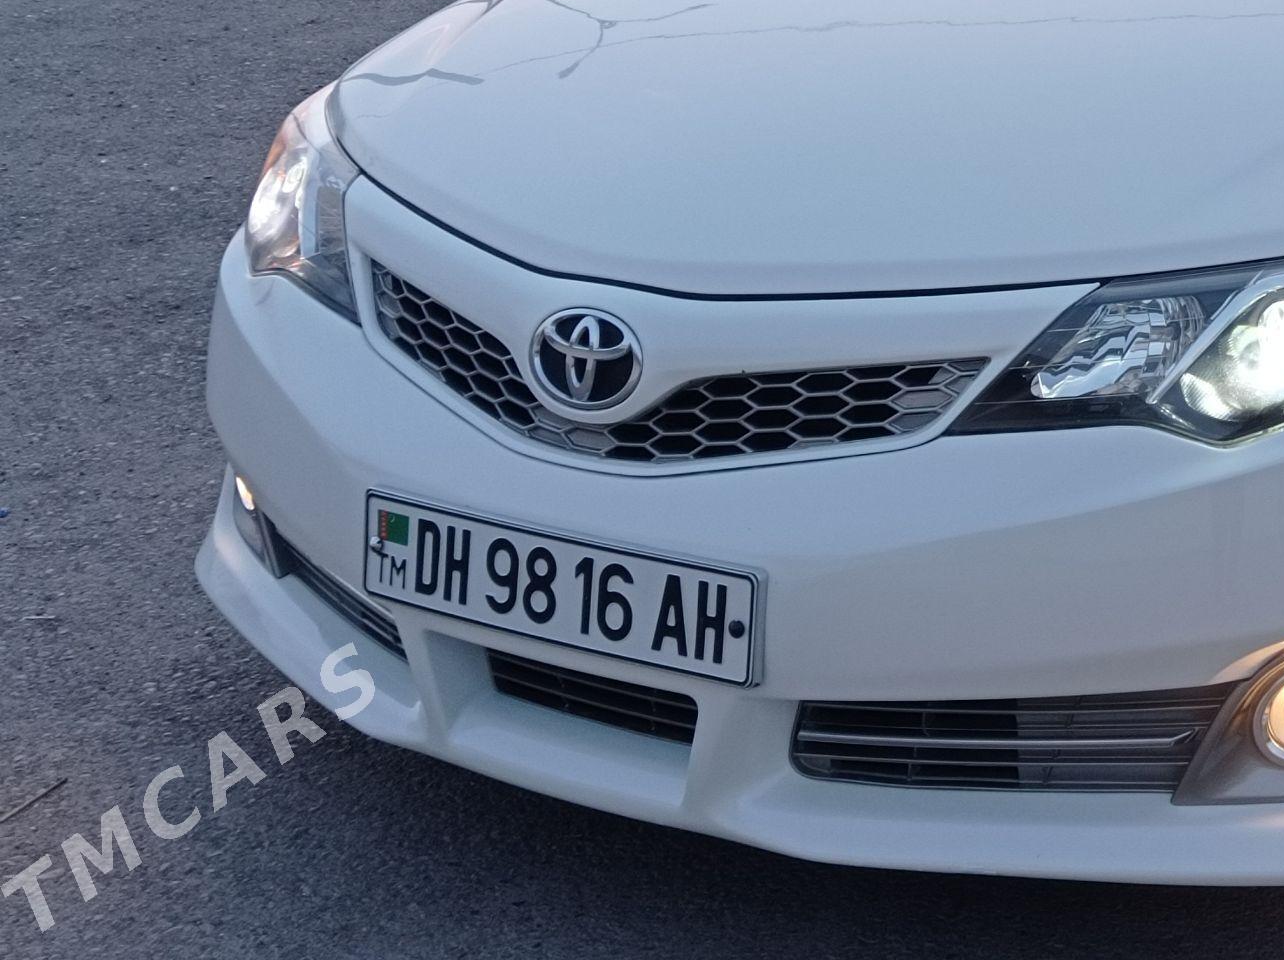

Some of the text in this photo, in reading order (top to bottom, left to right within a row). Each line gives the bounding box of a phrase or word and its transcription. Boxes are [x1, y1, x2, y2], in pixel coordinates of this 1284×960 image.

[375, 550, 407, 590] TM
[414, 518, 472, 606] DH
[651, 573, 728, 664] AH
